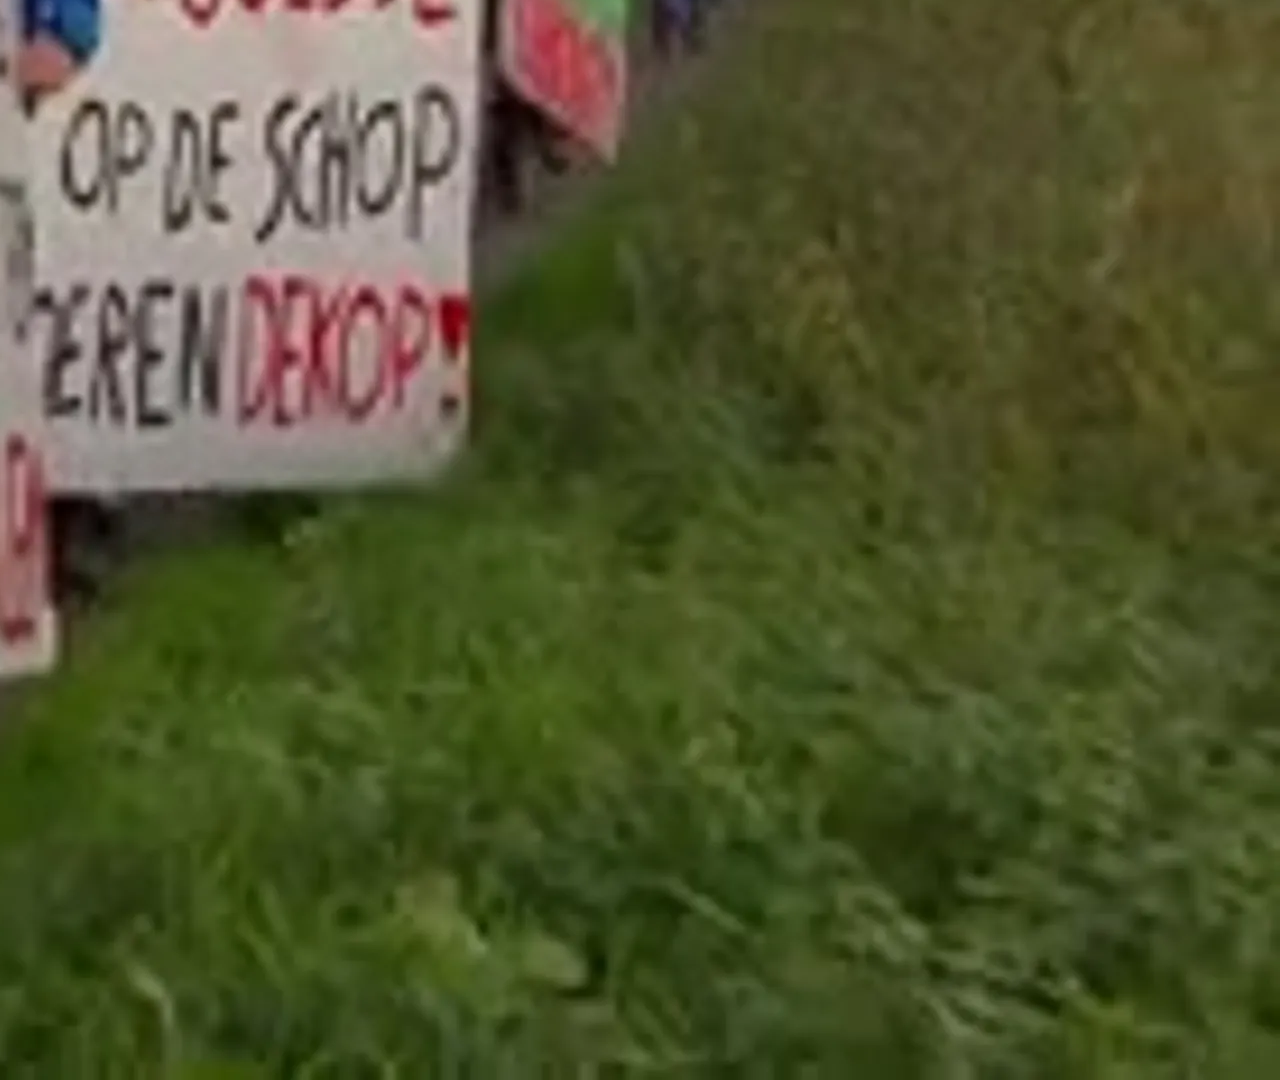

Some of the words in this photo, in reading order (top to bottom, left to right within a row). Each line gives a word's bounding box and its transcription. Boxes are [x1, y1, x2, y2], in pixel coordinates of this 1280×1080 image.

[60, 98, 156, 220] OP
[163, 102, 240, 233] DE
[253, 83, 463, 246] SCHOP
